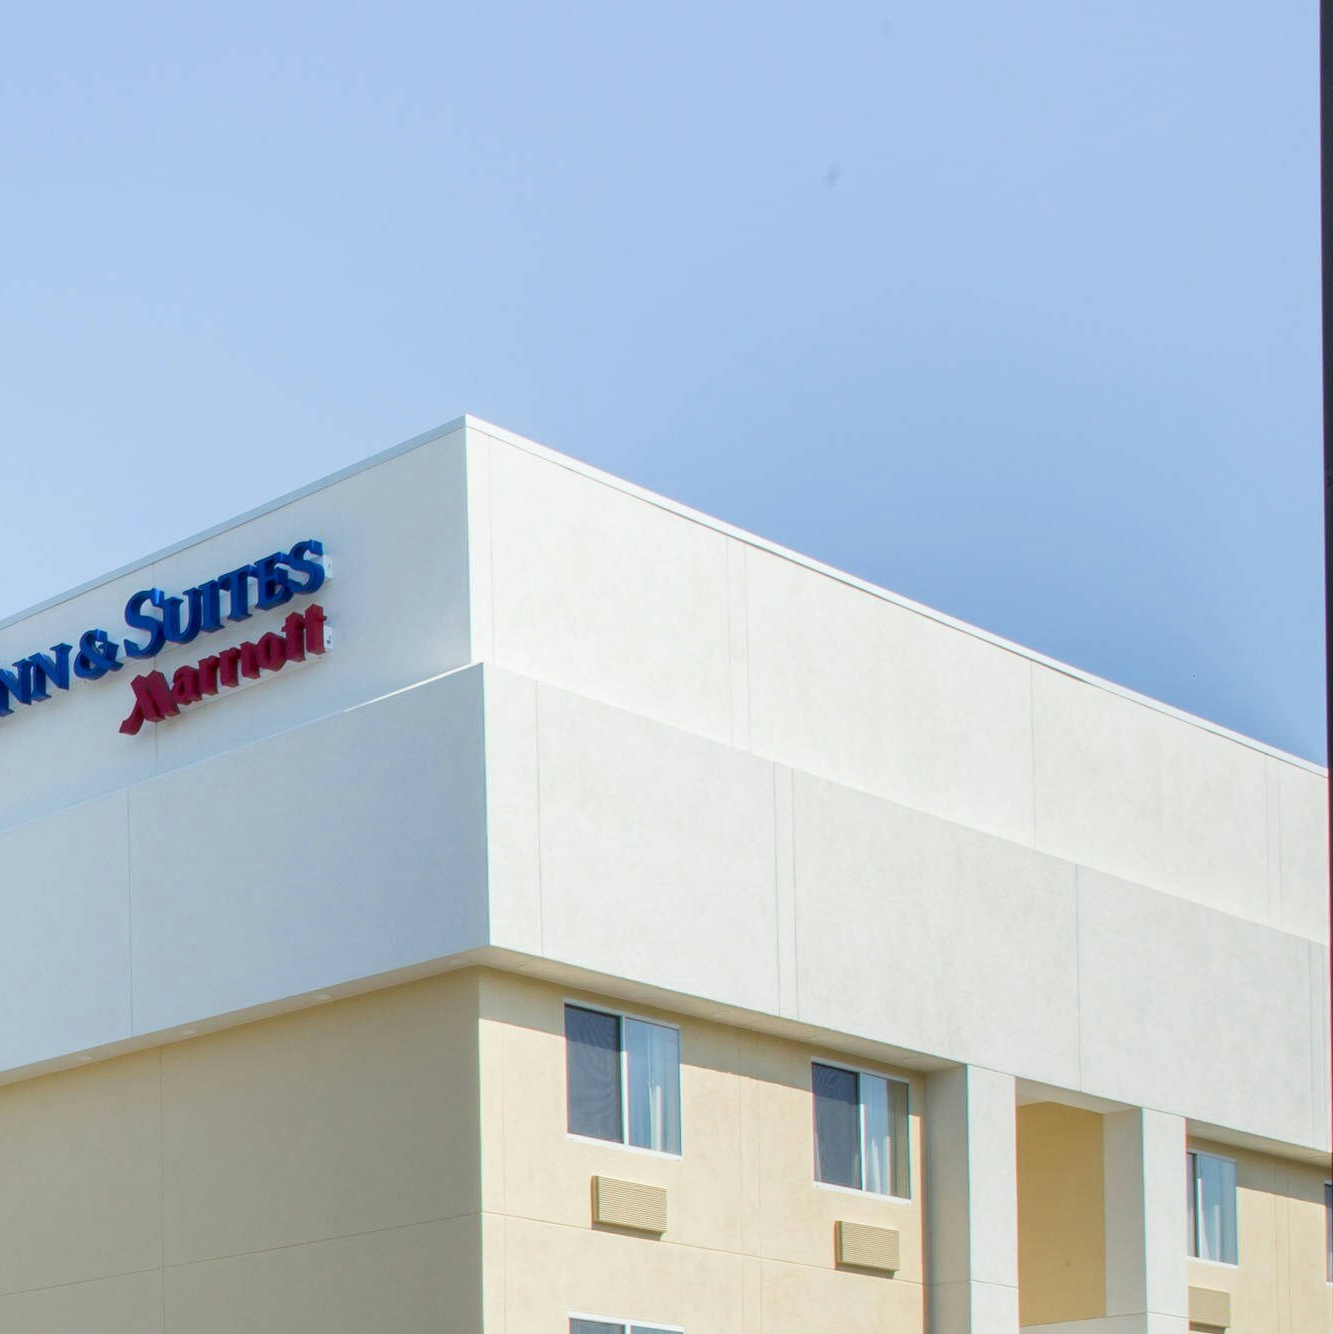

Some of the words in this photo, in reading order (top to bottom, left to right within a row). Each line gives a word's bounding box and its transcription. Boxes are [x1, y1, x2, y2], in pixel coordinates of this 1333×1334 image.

[73, 629, 124, 680] &
[123, 539, 326, 660] SUITES
[119, 603, 328, 735] Marriott
